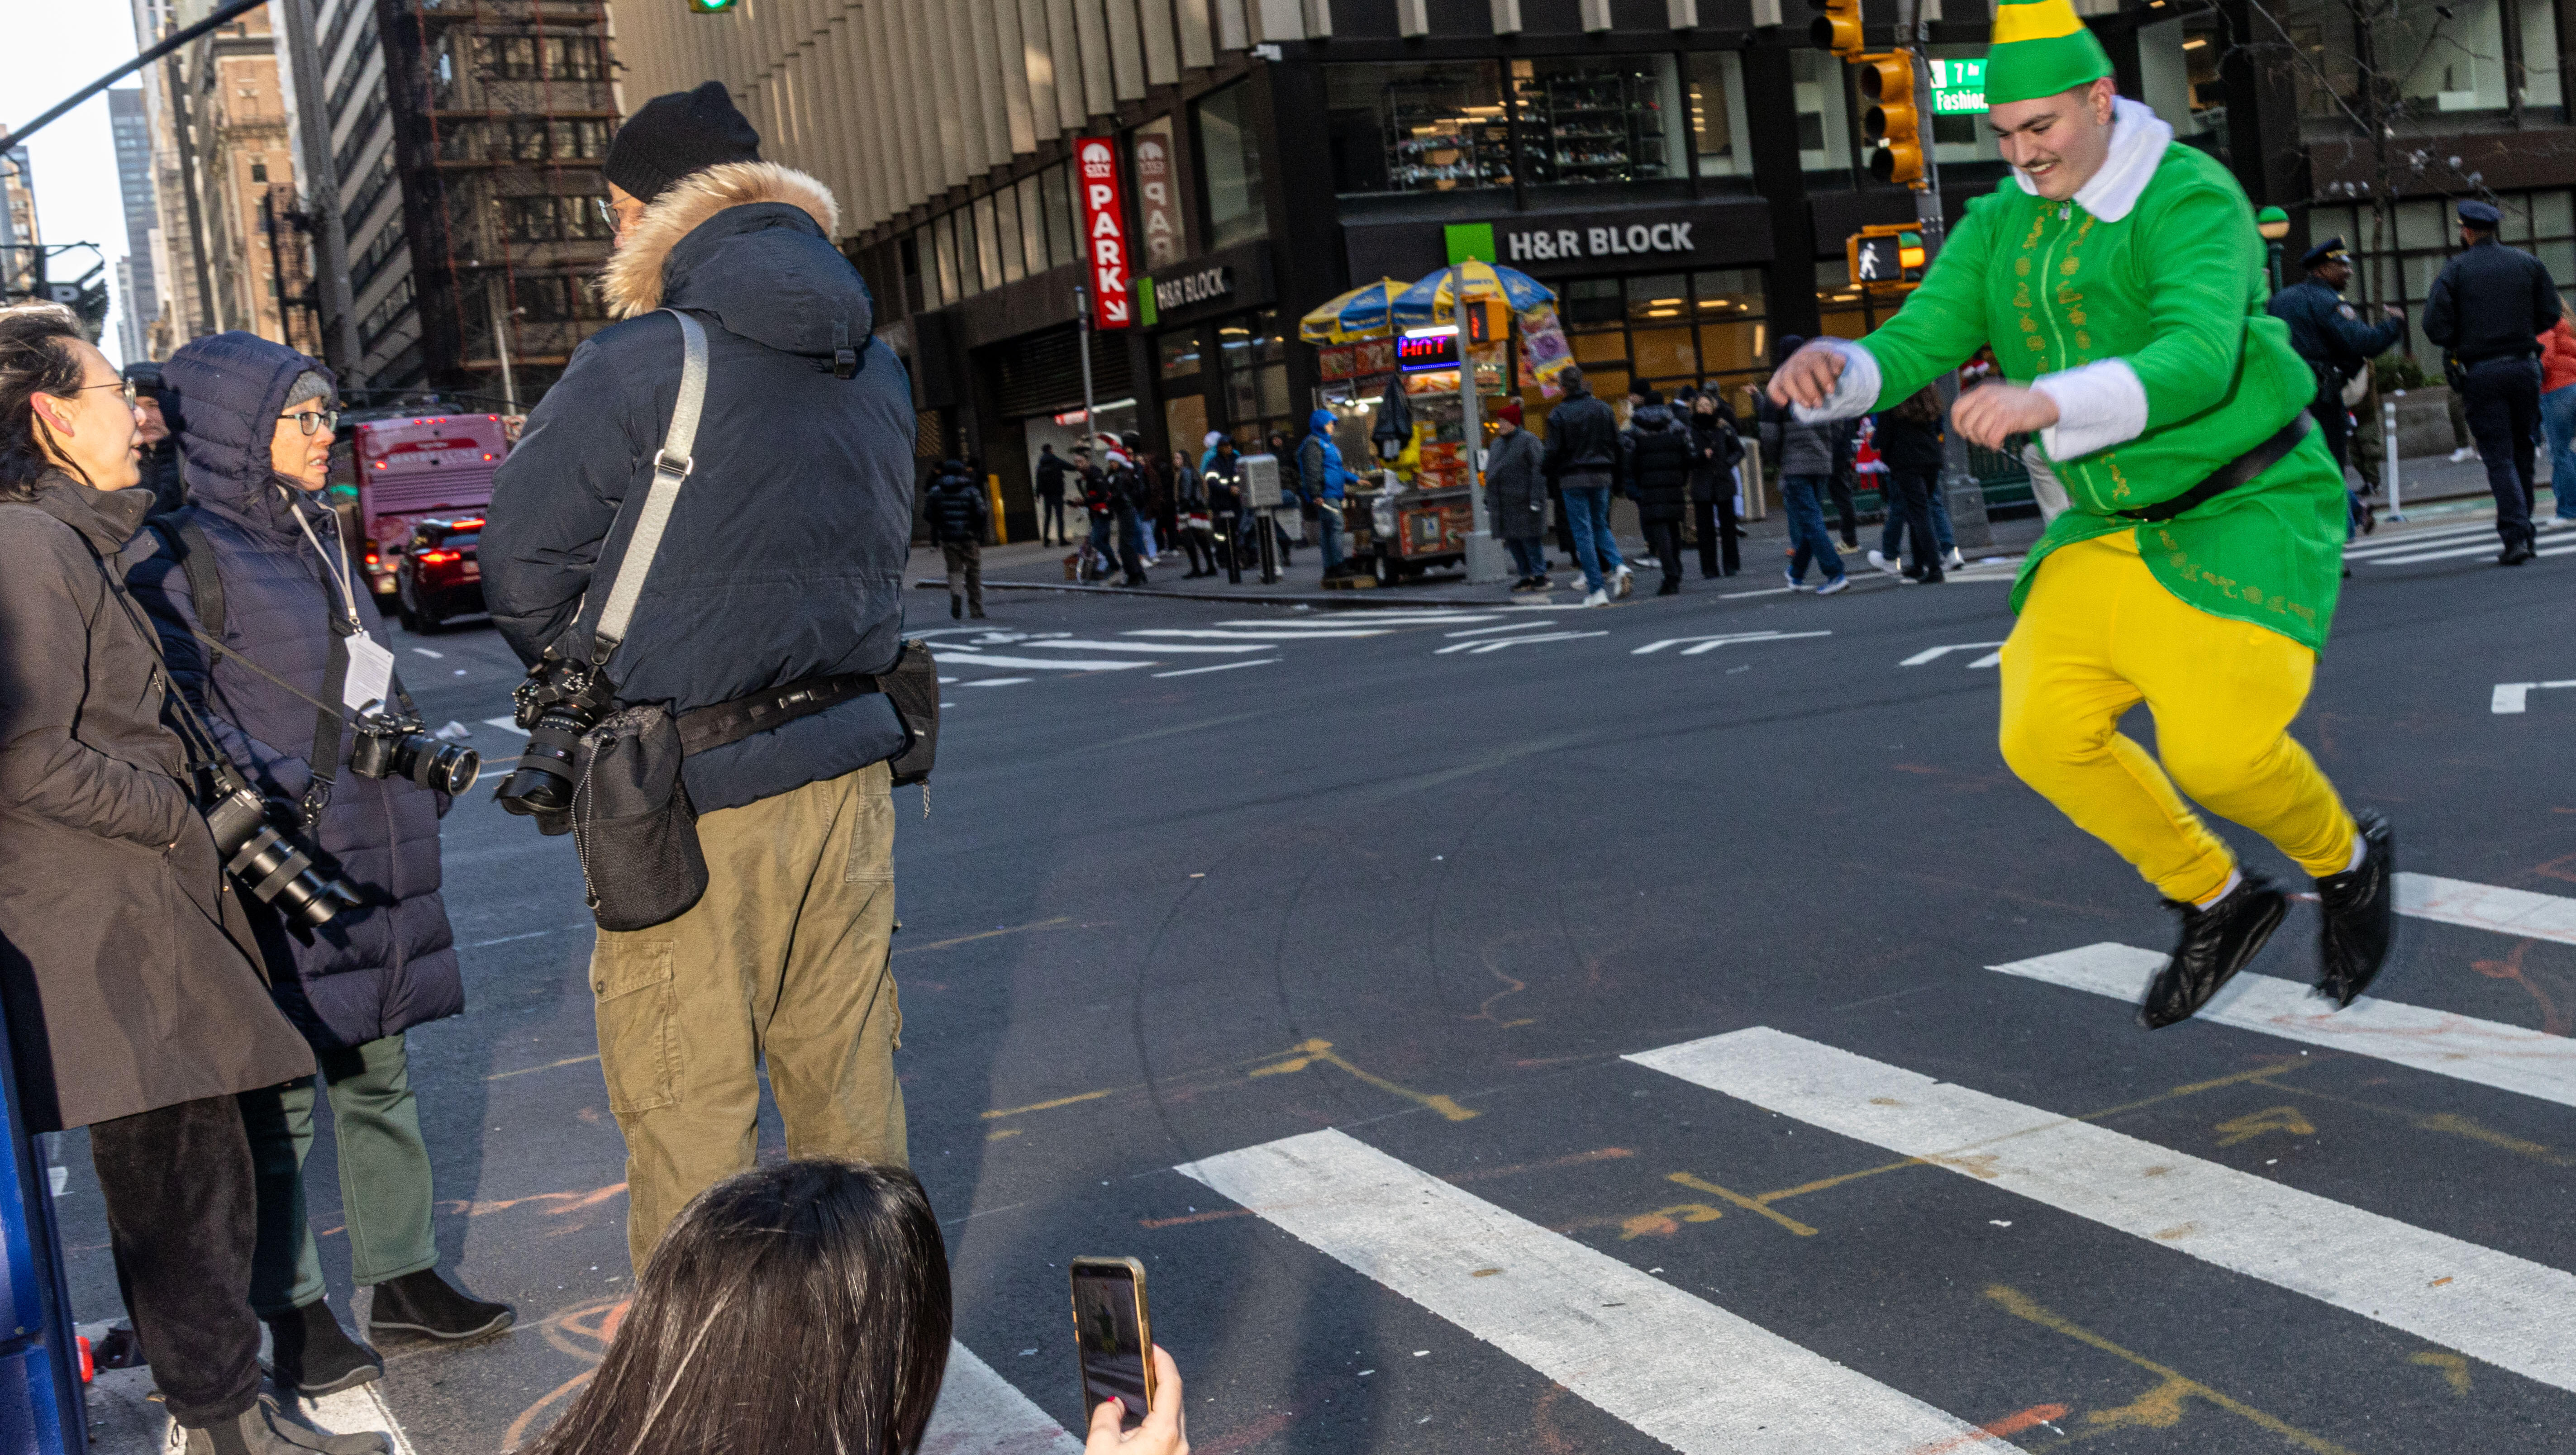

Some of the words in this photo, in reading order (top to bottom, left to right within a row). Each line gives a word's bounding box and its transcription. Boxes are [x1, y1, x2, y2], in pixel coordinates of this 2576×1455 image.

[1954, 63, 1963, 83] 7
[1088, 184, 1126, 293] PARK
[1508, 230, 1582, 261] H&R
[1587, 222, 1695, 256] BLOCK
[1184, 267, 1225, 303] BLOCK
